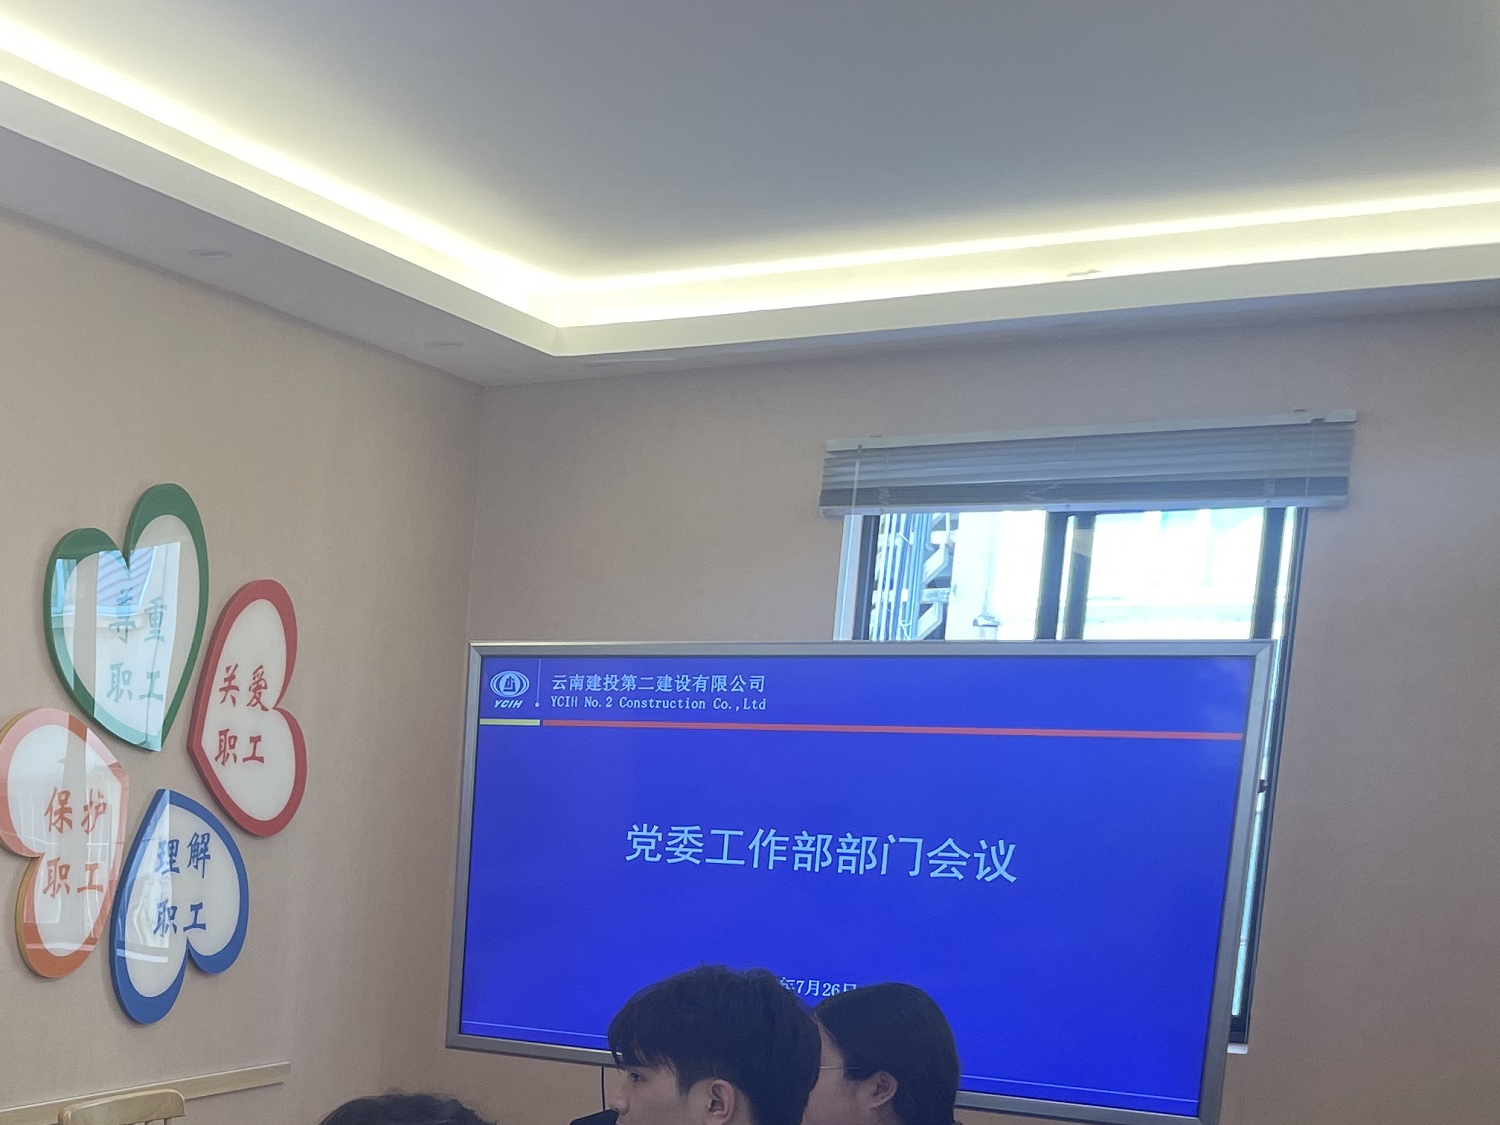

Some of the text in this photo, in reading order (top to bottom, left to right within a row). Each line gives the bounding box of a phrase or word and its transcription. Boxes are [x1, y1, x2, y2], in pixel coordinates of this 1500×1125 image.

[106, 662, 164, 703] 职工
[219, 664, 269, 711] 关爱
[550, 695, 767, 711] YCIH No.2 Construction Co.,Ltd
[551, 673, 765, 693] 云南建投第二建设有限公司
[494, 700, 523, 709] YCIH
[214, 727, 265, 765] 职工
[44, 786, 107, 834] 保护
[155, 831, 211, 879] 理解
[624, 823, 1018, 884] 党委工作部部门会议
[42, 856, 105, 898] 职工
[152, 901, 207, 936] 职工
